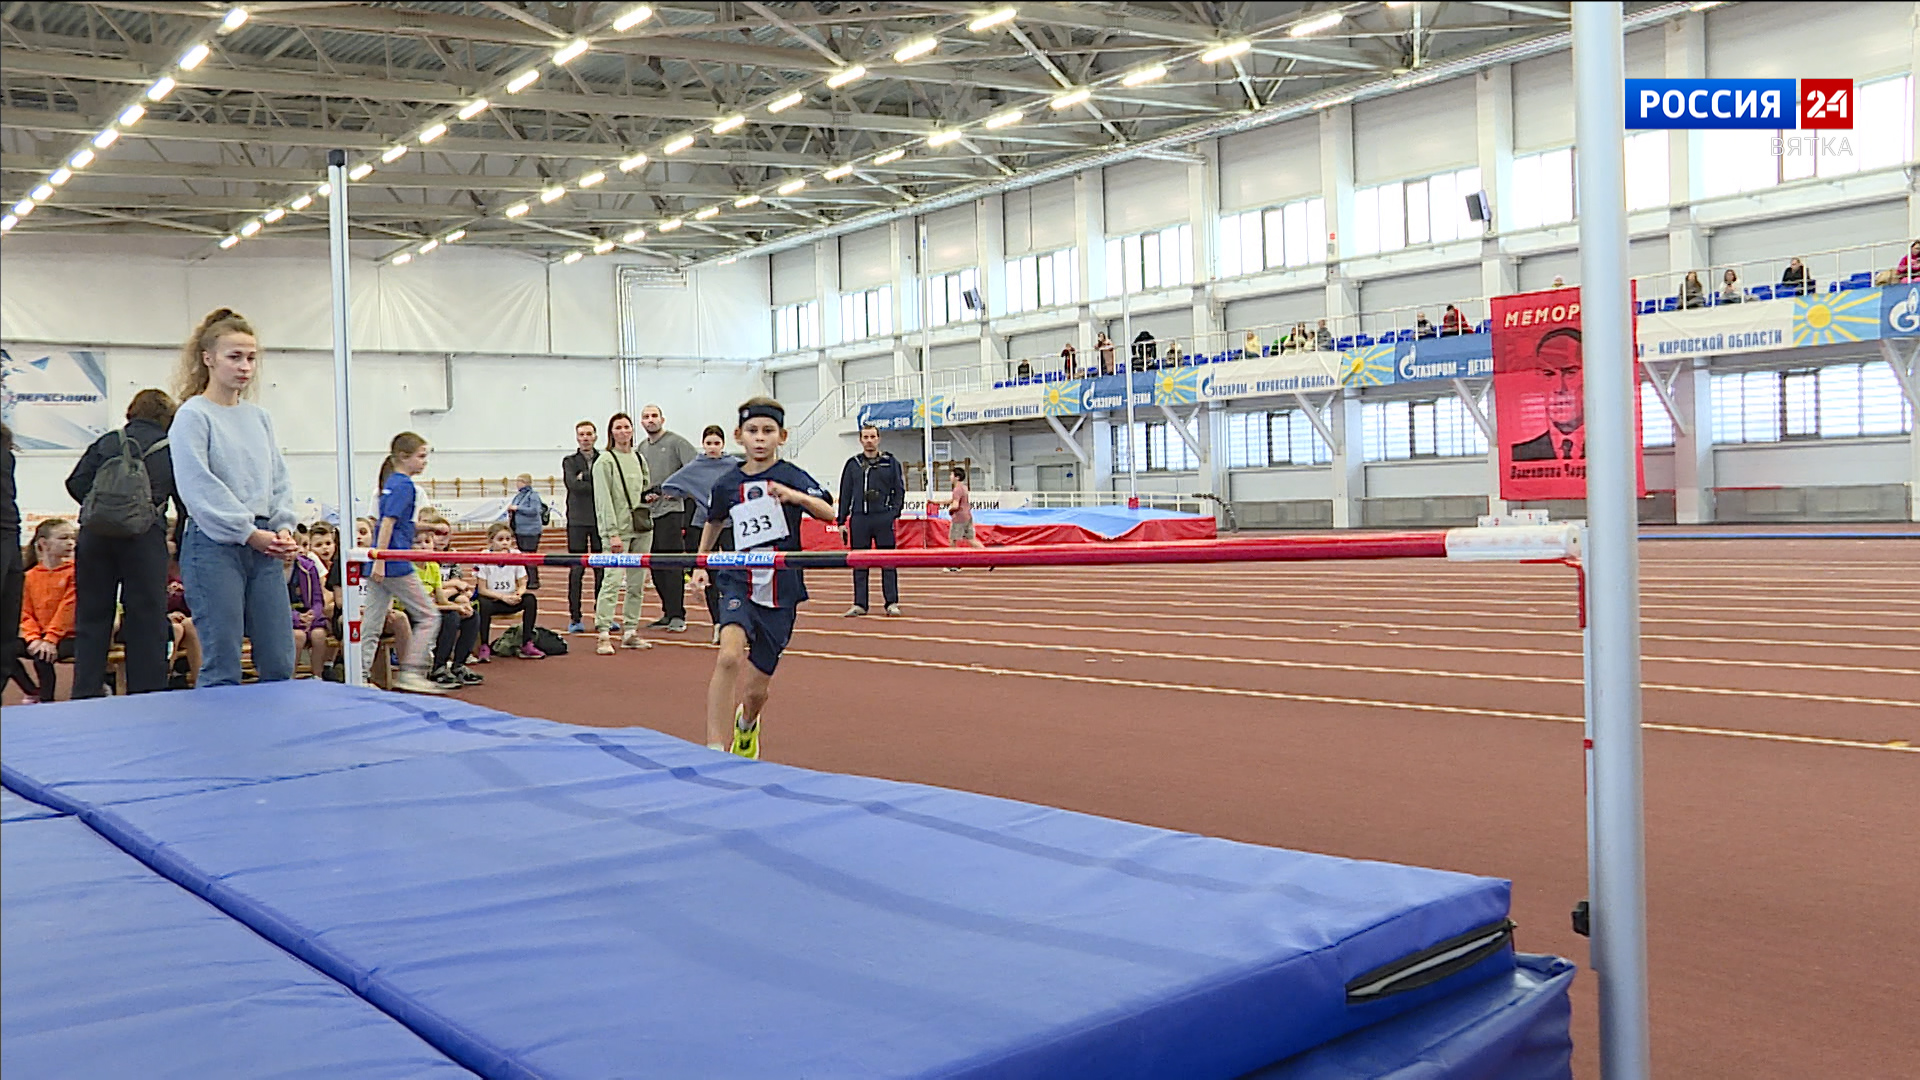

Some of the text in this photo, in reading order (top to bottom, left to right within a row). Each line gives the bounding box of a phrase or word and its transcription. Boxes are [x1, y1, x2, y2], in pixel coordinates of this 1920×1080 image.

[1504, 303, 1580, 328] МЕМОР
[1658, 333, 1724, 355] КИРОВСКОЙ
[1728, 329, 1783, 349] ОБЛАСТИ
[904, 502, 926, 510] ПОРТ
[739, 515, 772, 537] 233
